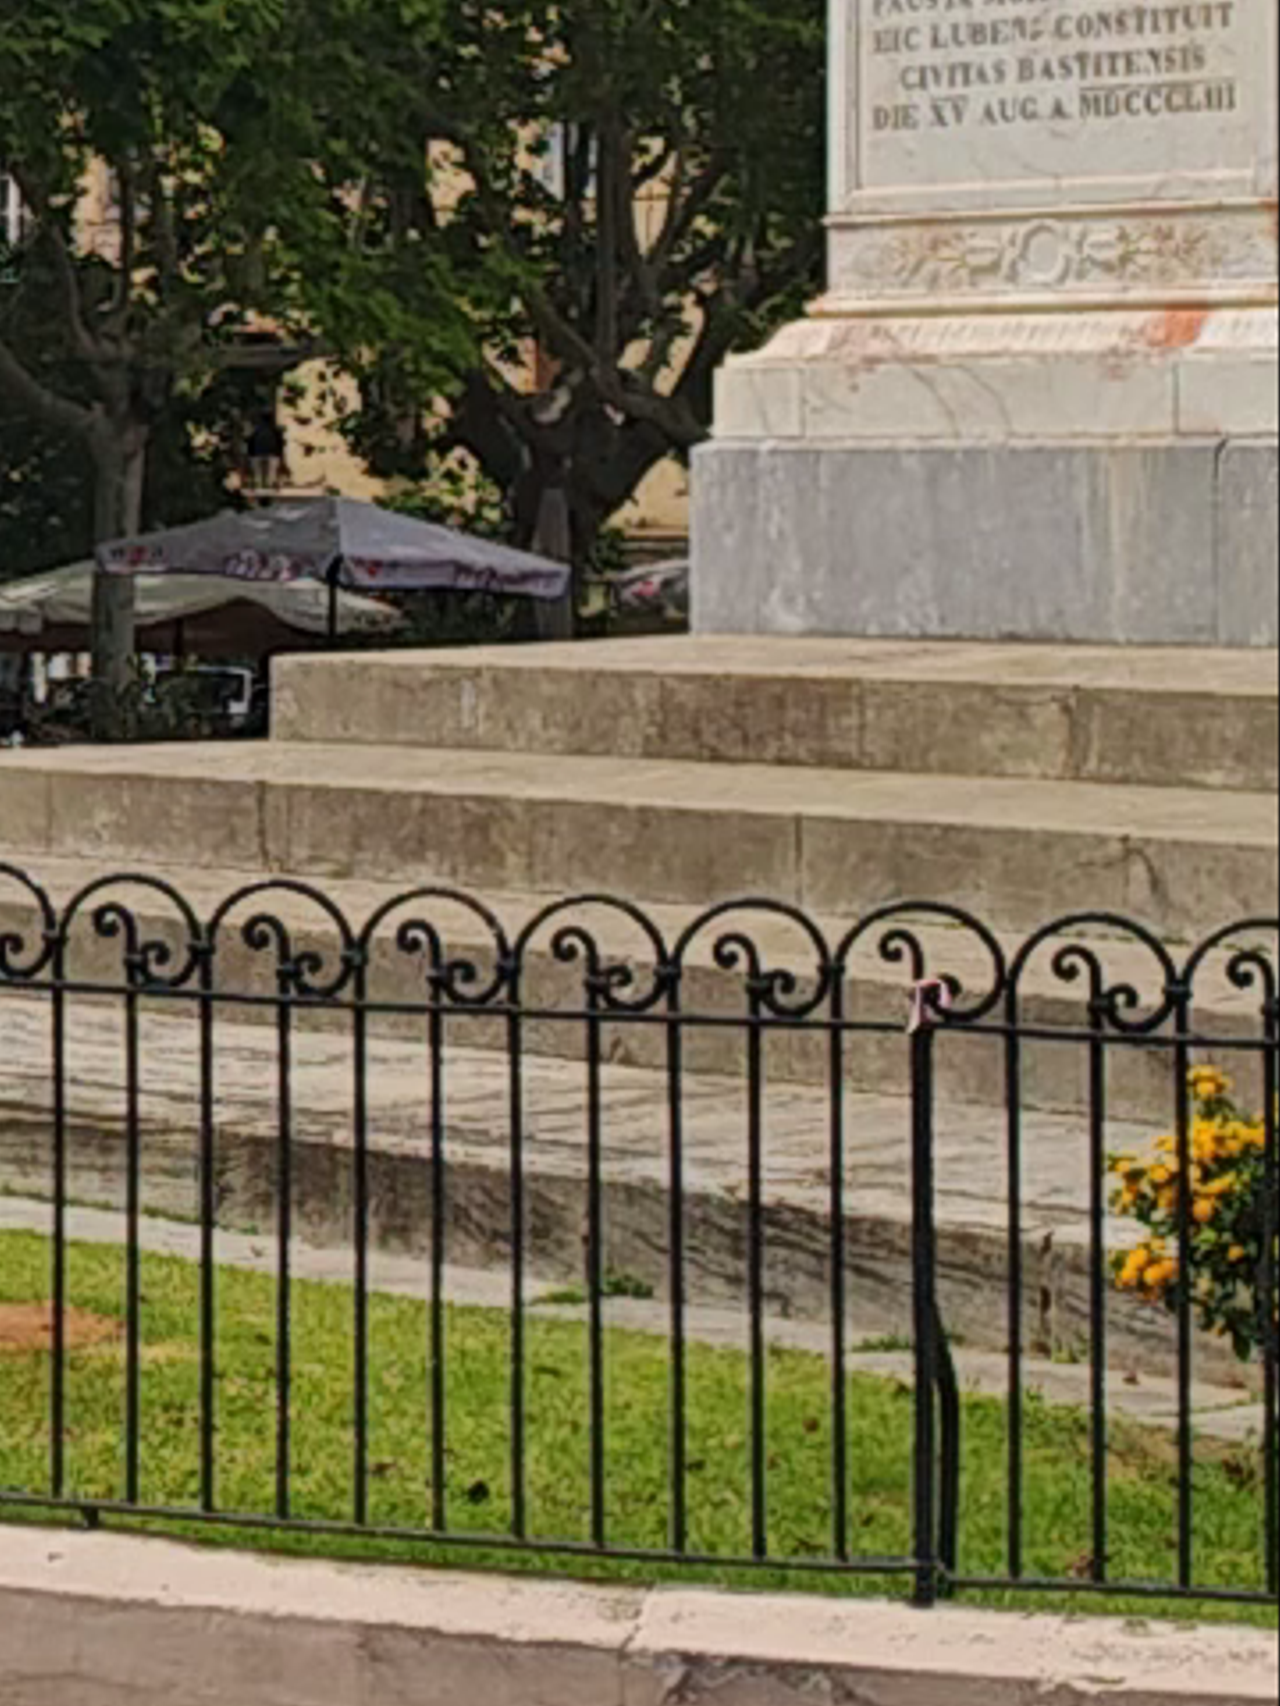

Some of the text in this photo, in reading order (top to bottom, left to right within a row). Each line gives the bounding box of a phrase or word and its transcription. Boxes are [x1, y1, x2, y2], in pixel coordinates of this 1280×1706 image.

[930, 16, 1044, 49] LUBENS
[1054, 1, 1233, 40] CONSTITUIT
[900, 45, 1206, 90] CIVITAS BASTITENSIS
[872, 104, 920, 131] DIE
[930, 95, 969, 127] XV
[981, 96, 1038, 126] AUG
[1079, 79, 1236, 119] MDCCCLIII
